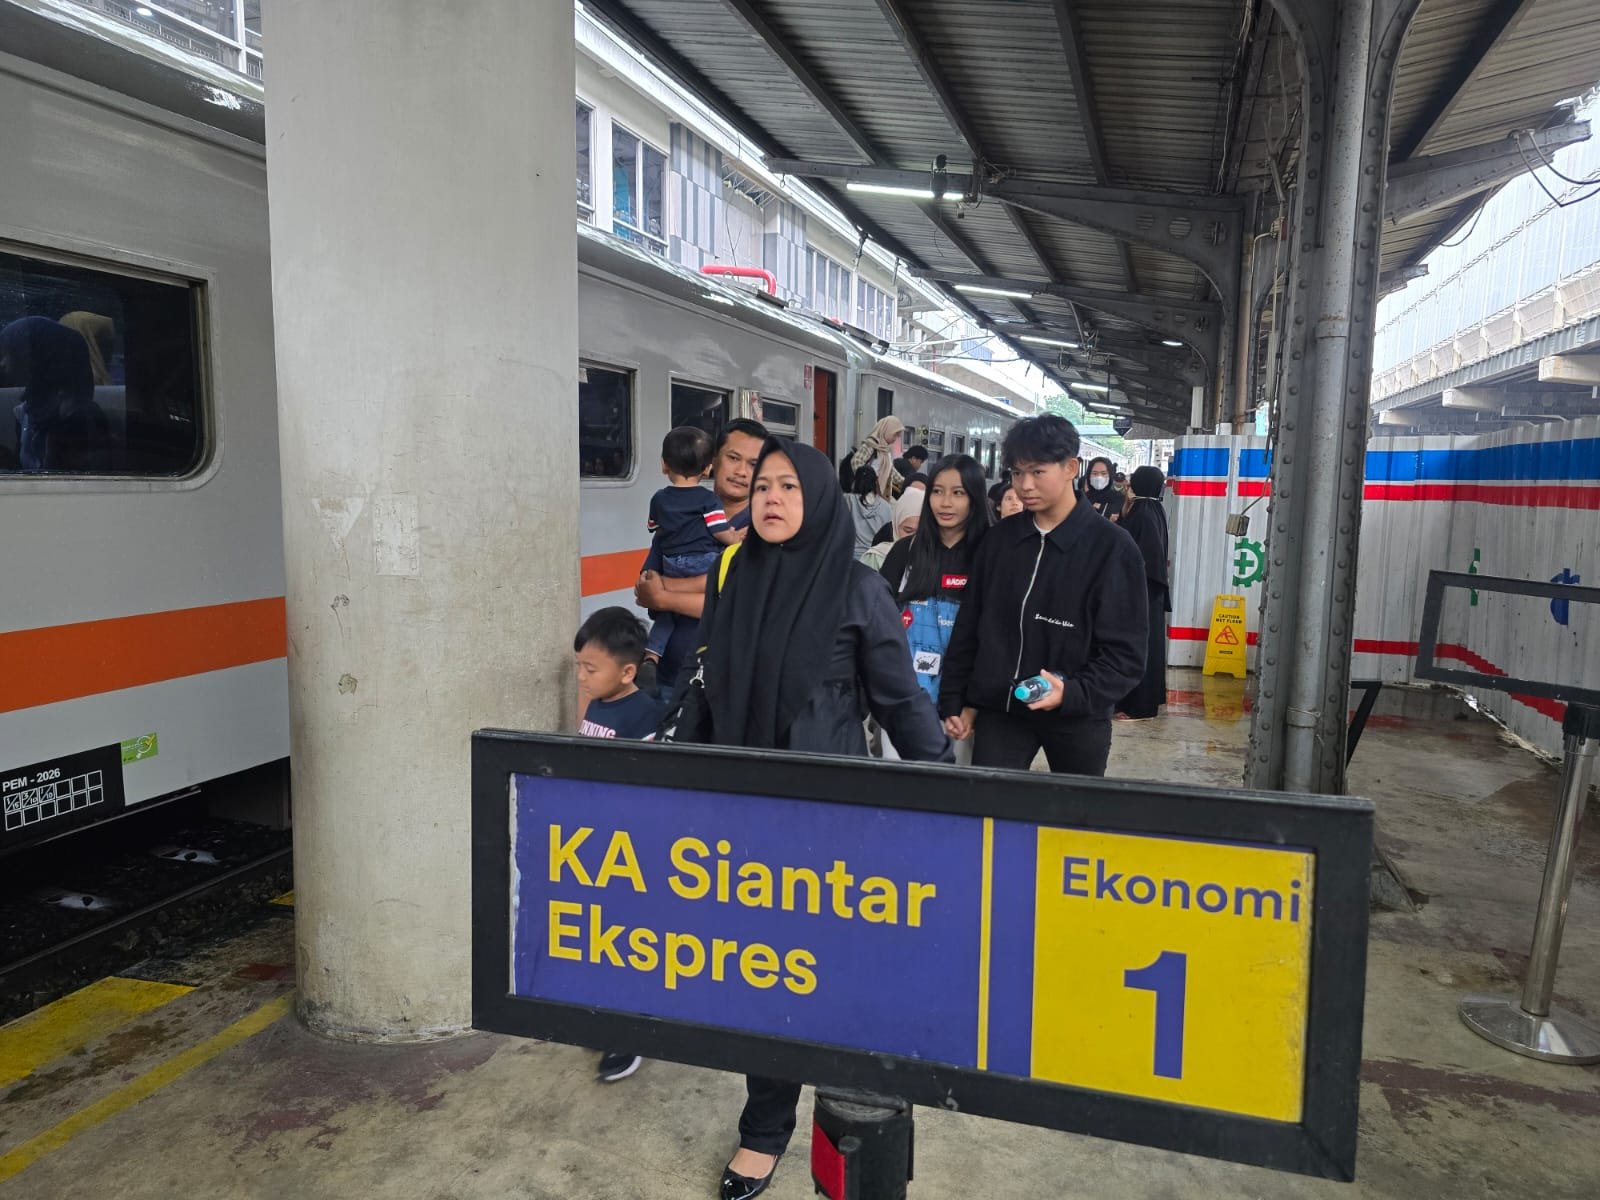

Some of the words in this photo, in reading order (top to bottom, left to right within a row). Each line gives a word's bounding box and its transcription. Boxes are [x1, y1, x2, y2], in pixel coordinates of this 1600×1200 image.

[2, 777, 28, 792] PEM
[36, 768, 61, 783] 2026
[548, 823, 647, 893] KA
[667, 836, 937, 928] Siantar
[1062, 855, 1302, 923] Ekonomi
[548, 899, 818, 996] Ekspres
[1123, 950, 1188, 1081] 1
